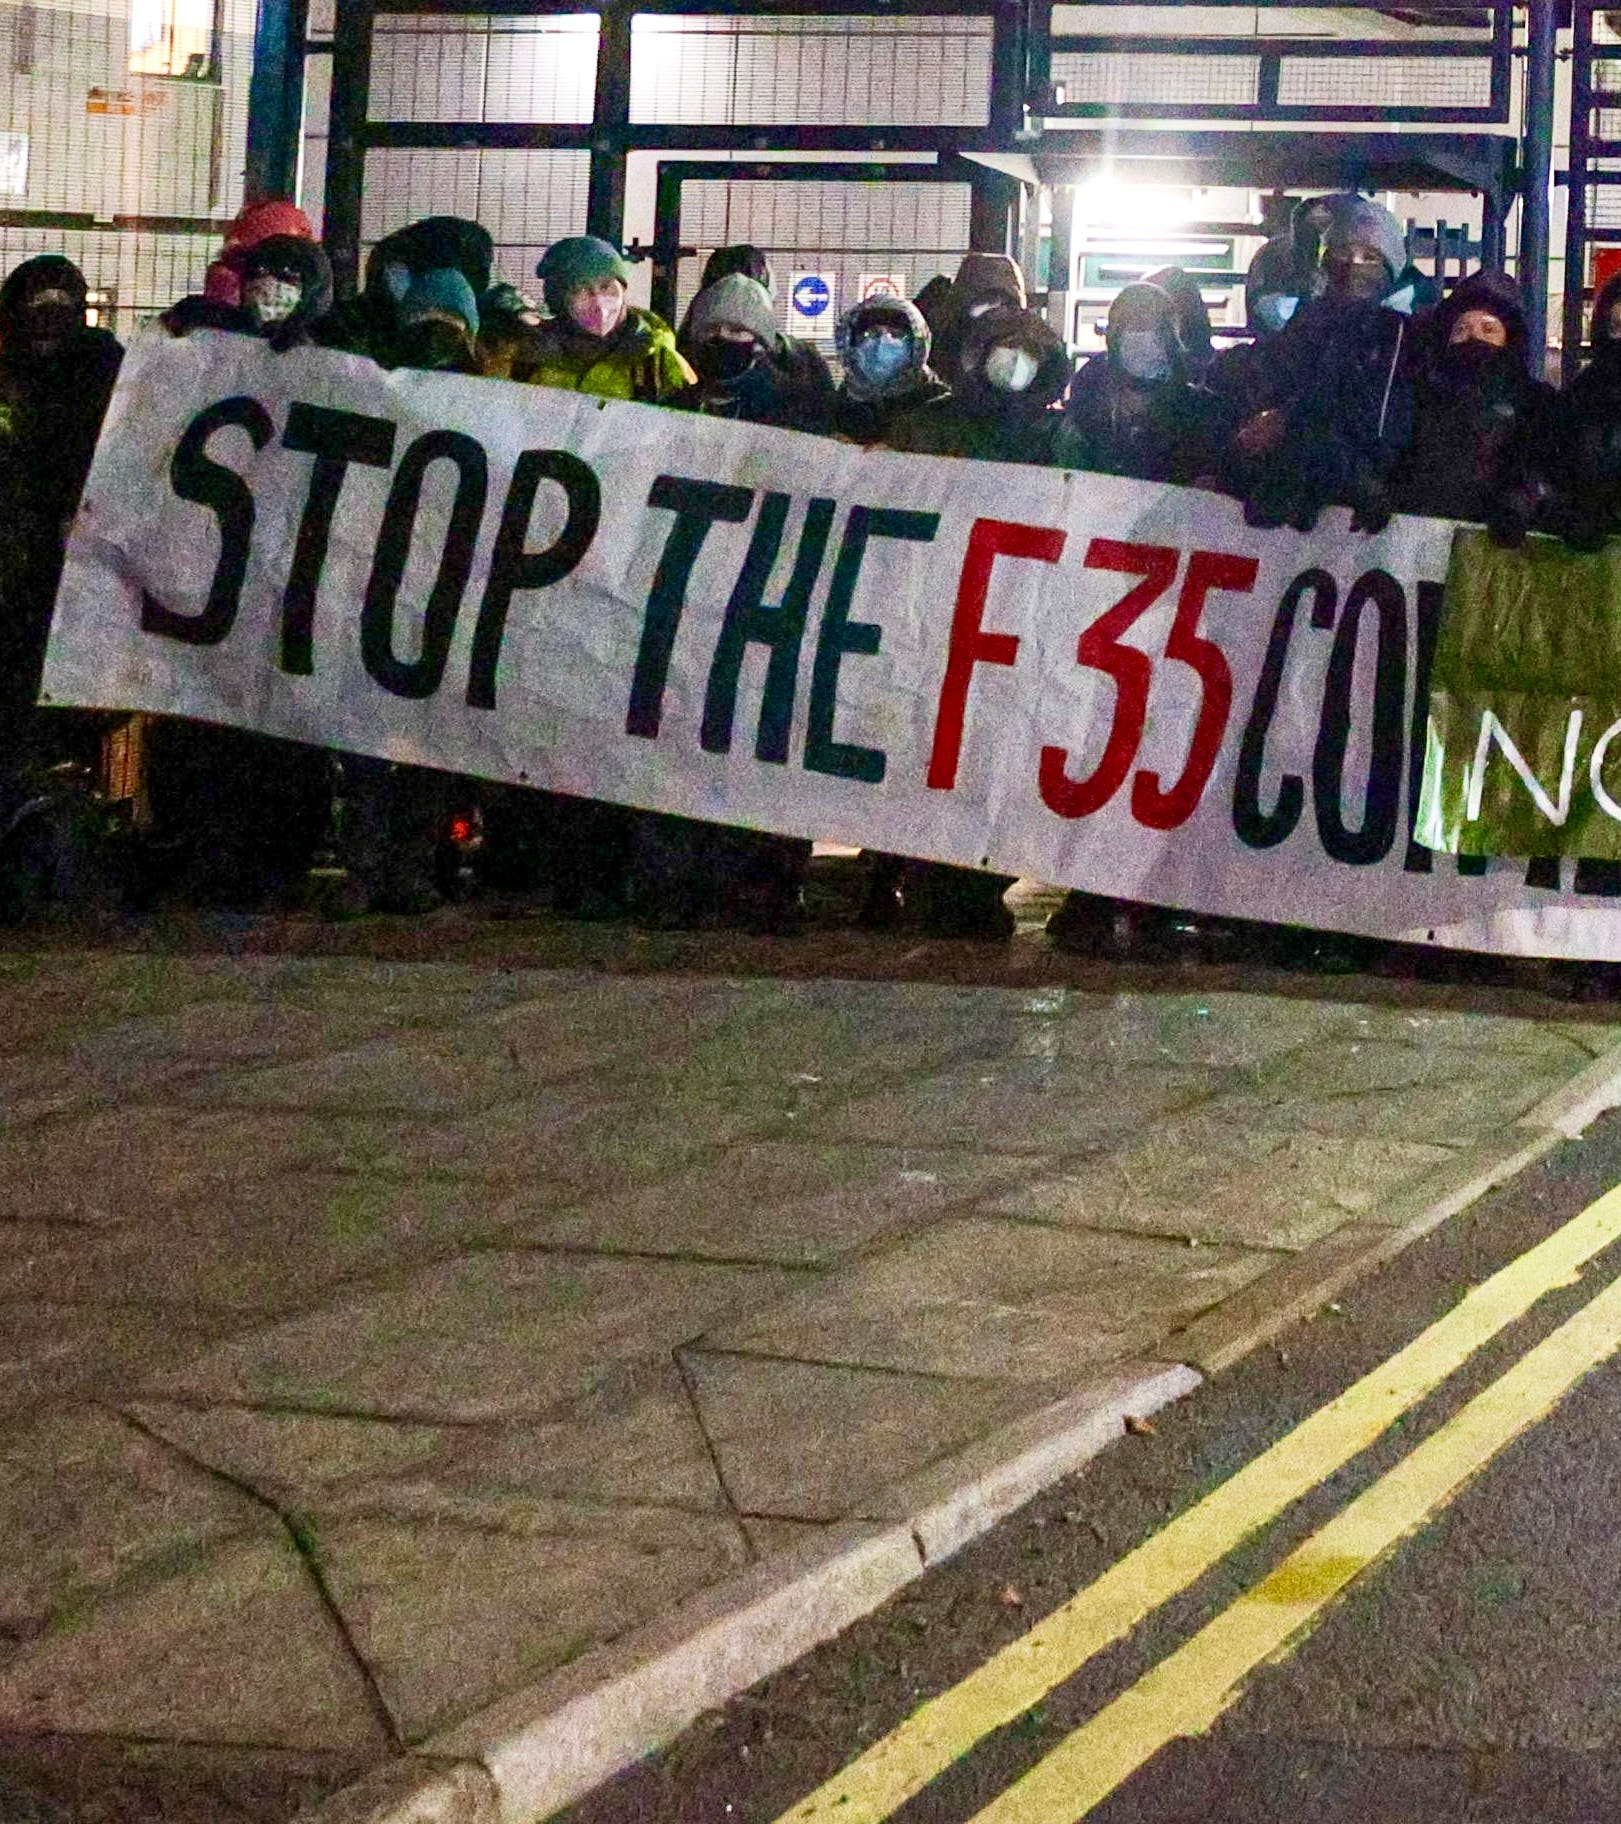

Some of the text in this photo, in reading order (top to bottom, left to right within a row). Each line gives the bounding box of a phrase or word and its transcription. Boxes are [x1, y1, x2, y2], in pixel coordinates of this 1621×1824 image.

[141, 395, 603, 710] STOP
[625, 473, 942, 784] THE
[927, 517, 1260, 831] F35
